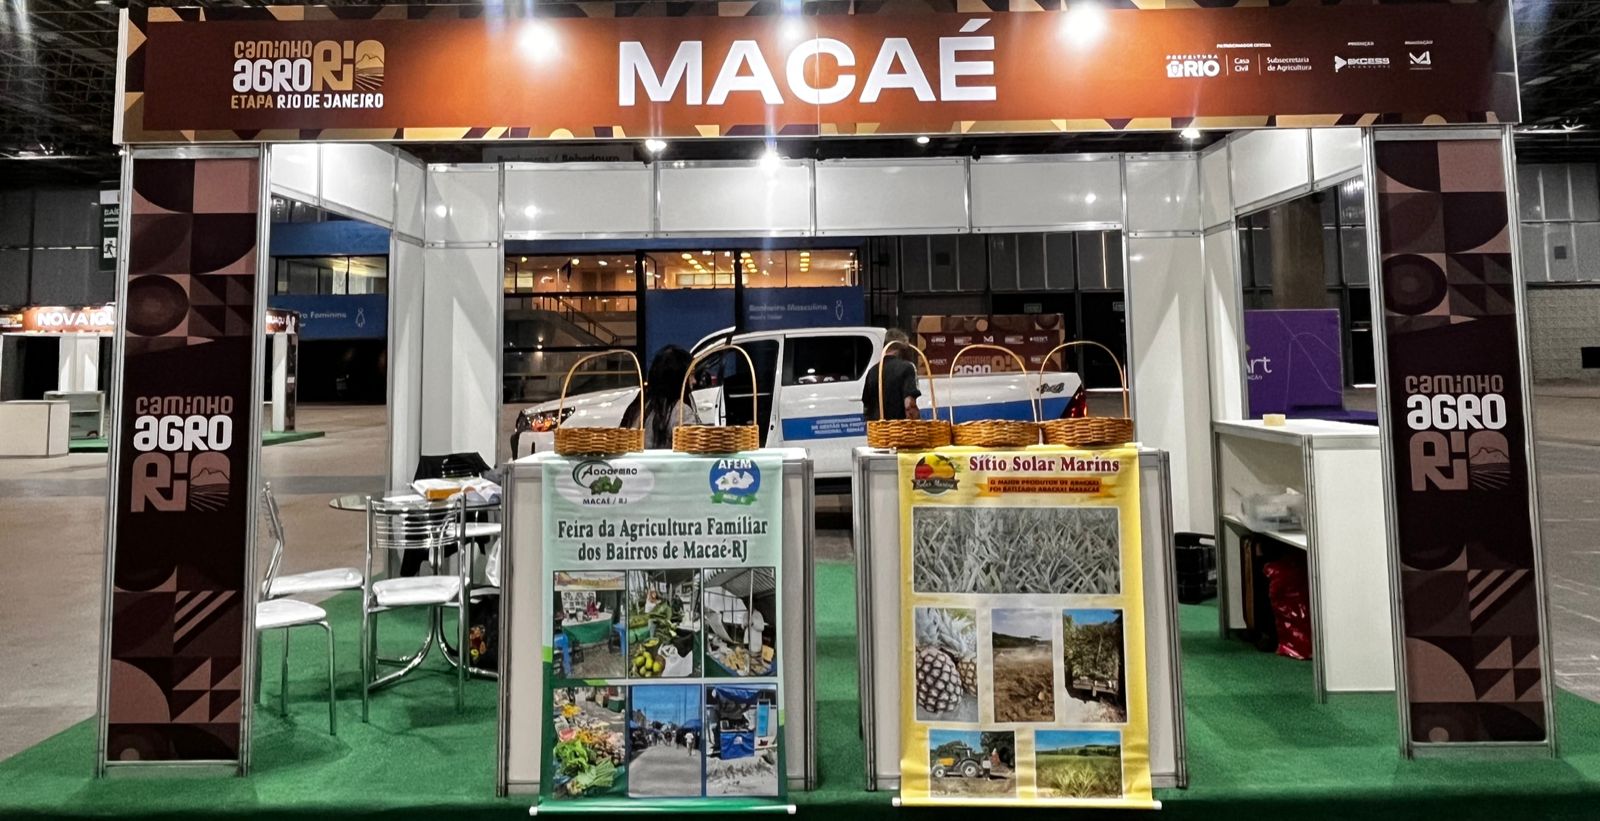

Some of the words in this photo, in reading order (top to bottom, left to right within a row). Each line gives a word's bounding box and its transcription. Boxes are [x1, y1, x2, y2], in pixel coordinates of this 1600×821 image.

[618, 18, 997, 106] MACAÉ
[1183, 60, 1220, 77] RIO
[1234, 64, 1249, 72] Civil
[1267, 64, 1275, 72] de
[1276, 64, 1312, 72] Agricultura
[231, 95, 274, 109] ETAPA
[277, 94, 301, 109] RIO
[303, 94, 321, 109] DE
[323, 93, 384, 109] JANEIRO
[38, 311, 87, 326] NOVA
[718, 459, 752, 469] AFEM
[970, 455, 1007, 471] Sítio
[1013, 456, 1055, 471] Solar
[1060, 457, 1120, 472] Marins
[582, 497, 611, 505] MACAÉ
[619, 497, 628, 505] RJ
[558, 520, 593, 538] Feira
[599, 519, 615, 537] da
[620, 518, 702, 542] Agricultura
[707, 516, 768, 535] Familiar
[578, 542, 601, 561] dos
[606, 541, 658, 561] Bairros
[663, 540, 678, 559] de
